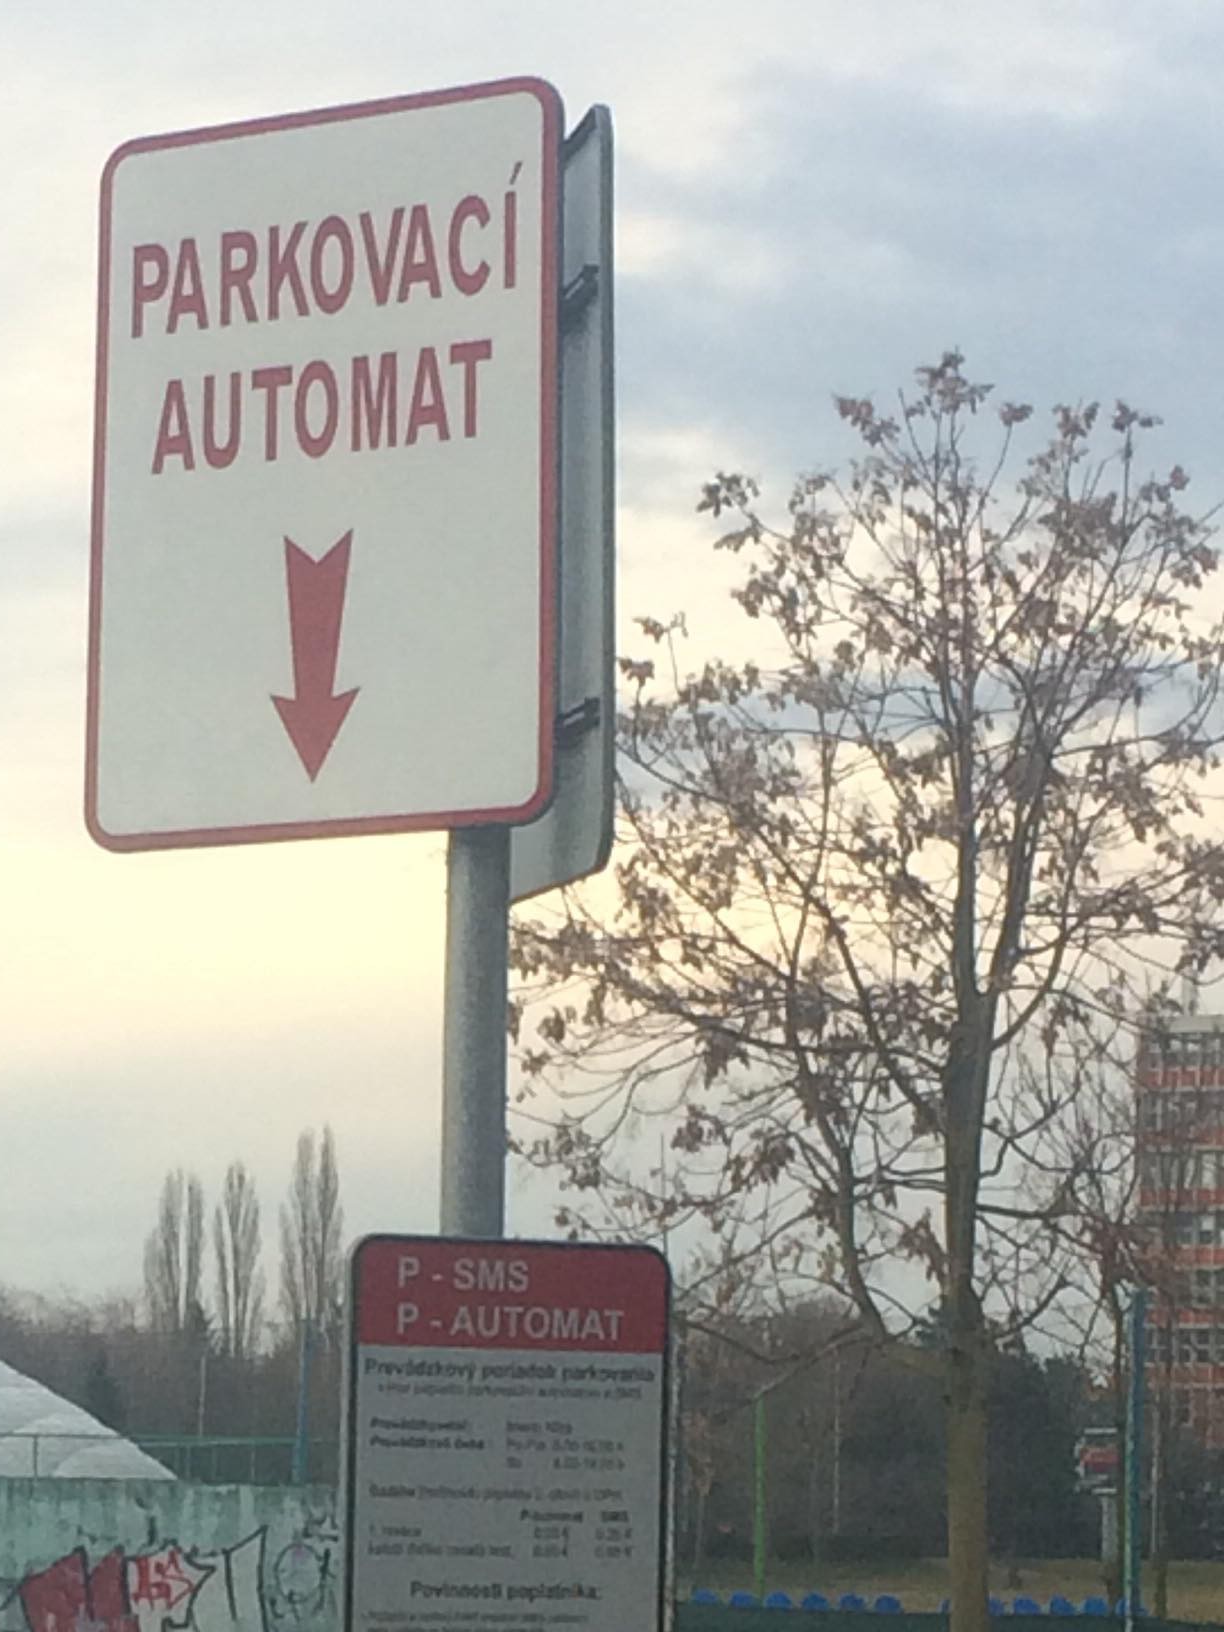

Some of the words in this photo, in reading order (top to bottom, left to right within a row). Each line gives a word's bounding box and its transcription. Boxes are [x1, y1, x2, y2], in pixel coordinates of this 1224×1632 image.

[131, 161, 523, 338] PARKOVACÍ
[151, 339, 492, 475] AUTOMAT
[397, 1255, 421, 1288] P
[452, 1257, 529, 1292] SMS
[449, 1305, 625, 1341] AUTOMAT
